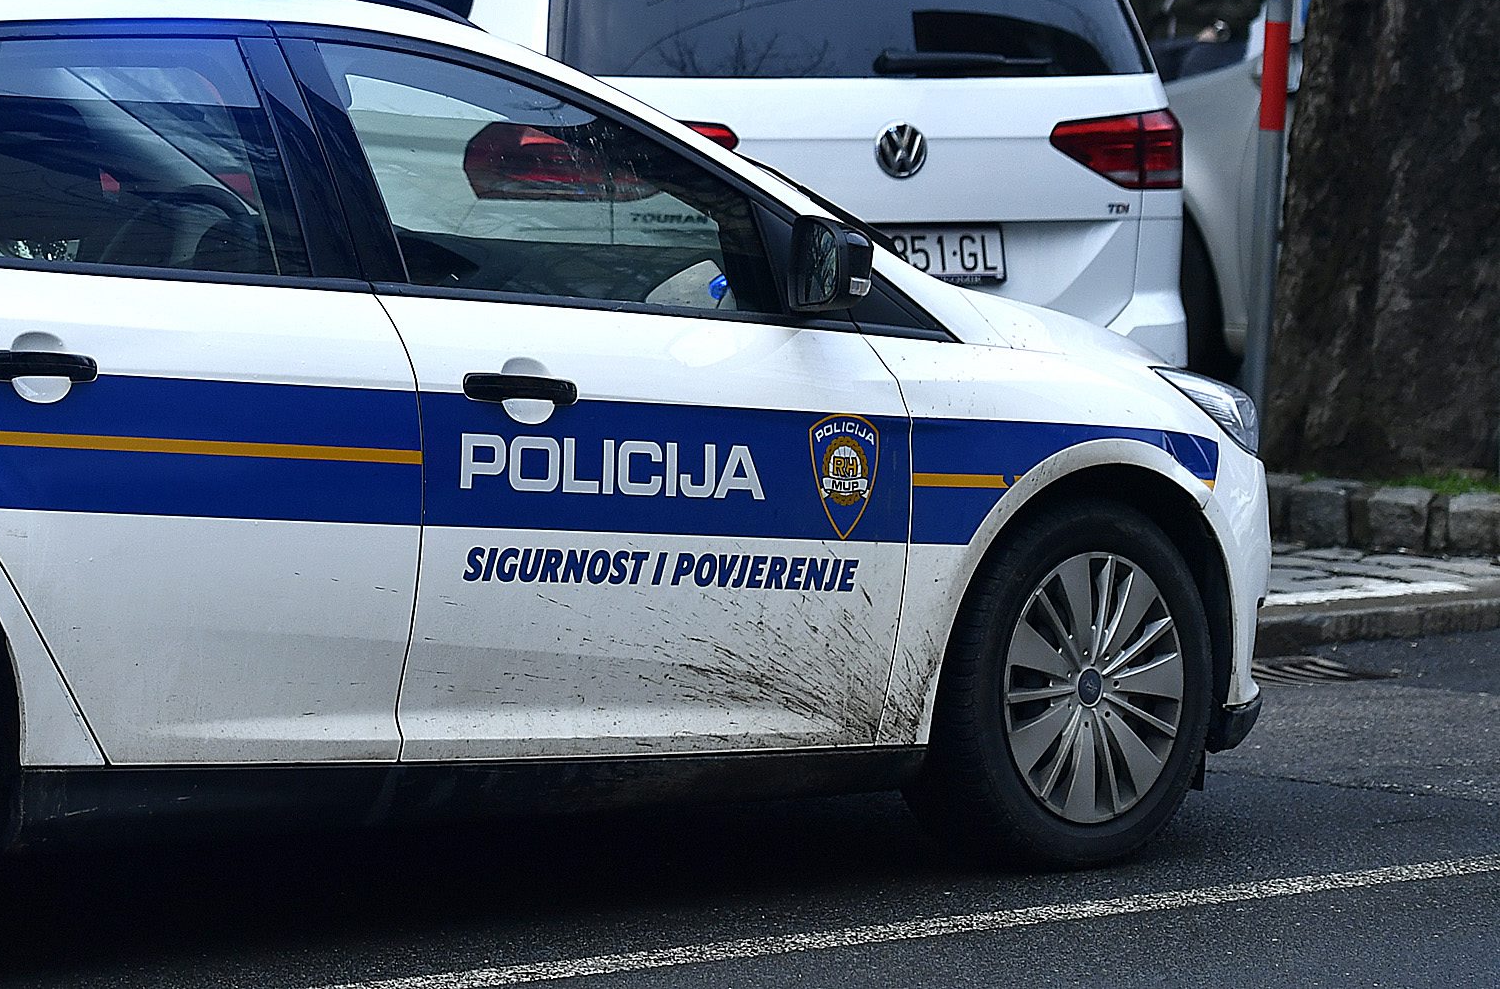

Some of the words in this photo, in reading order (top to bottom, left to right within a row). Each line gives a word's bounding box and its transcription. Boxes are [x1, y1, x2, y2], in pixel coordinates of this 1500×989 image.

[814, 421, 875, 446] POLICIJA
[460, 432, 765, 501] POLICIJA
[832, 456, 858, 477] RH
[831, 480, 859, 491] MUP
[463, 545, 649, 586] SIGURNOST
[651, 551, 667, 587] I
[670, 552, 860, 593] POVJERENJE
